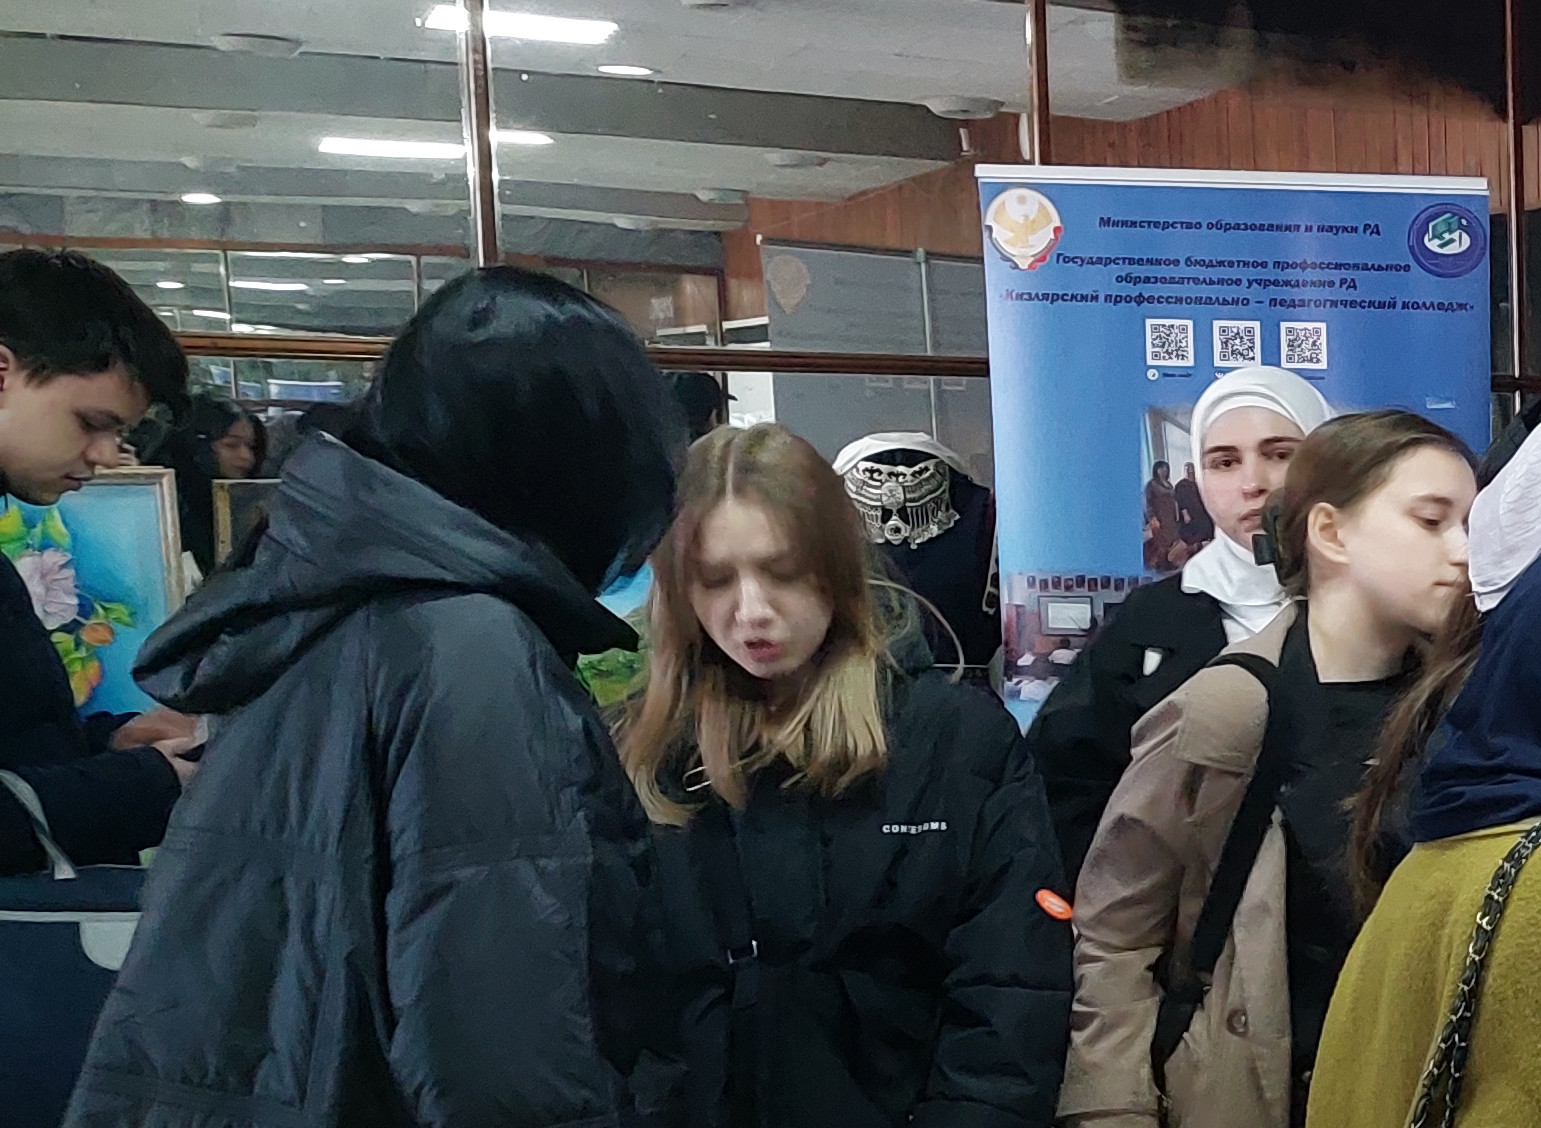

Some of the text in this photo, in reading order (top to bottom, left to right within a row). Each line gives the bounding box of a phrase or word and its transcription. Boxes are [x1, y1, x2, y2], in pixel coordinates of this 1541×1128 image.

[1099, 216, 1381, 237] Министерство образования и науки РД
[1056, 252, 1411, 273] Государственное бюджетное профессиональное
[1115, 272, 1358, 291] образовательное учреждение РД
[1000, 288, 1099, 305] Кизлярский
[1103, 292, 1249, 307] профессионально
[1269, 297, 1397, 312] педагогический
